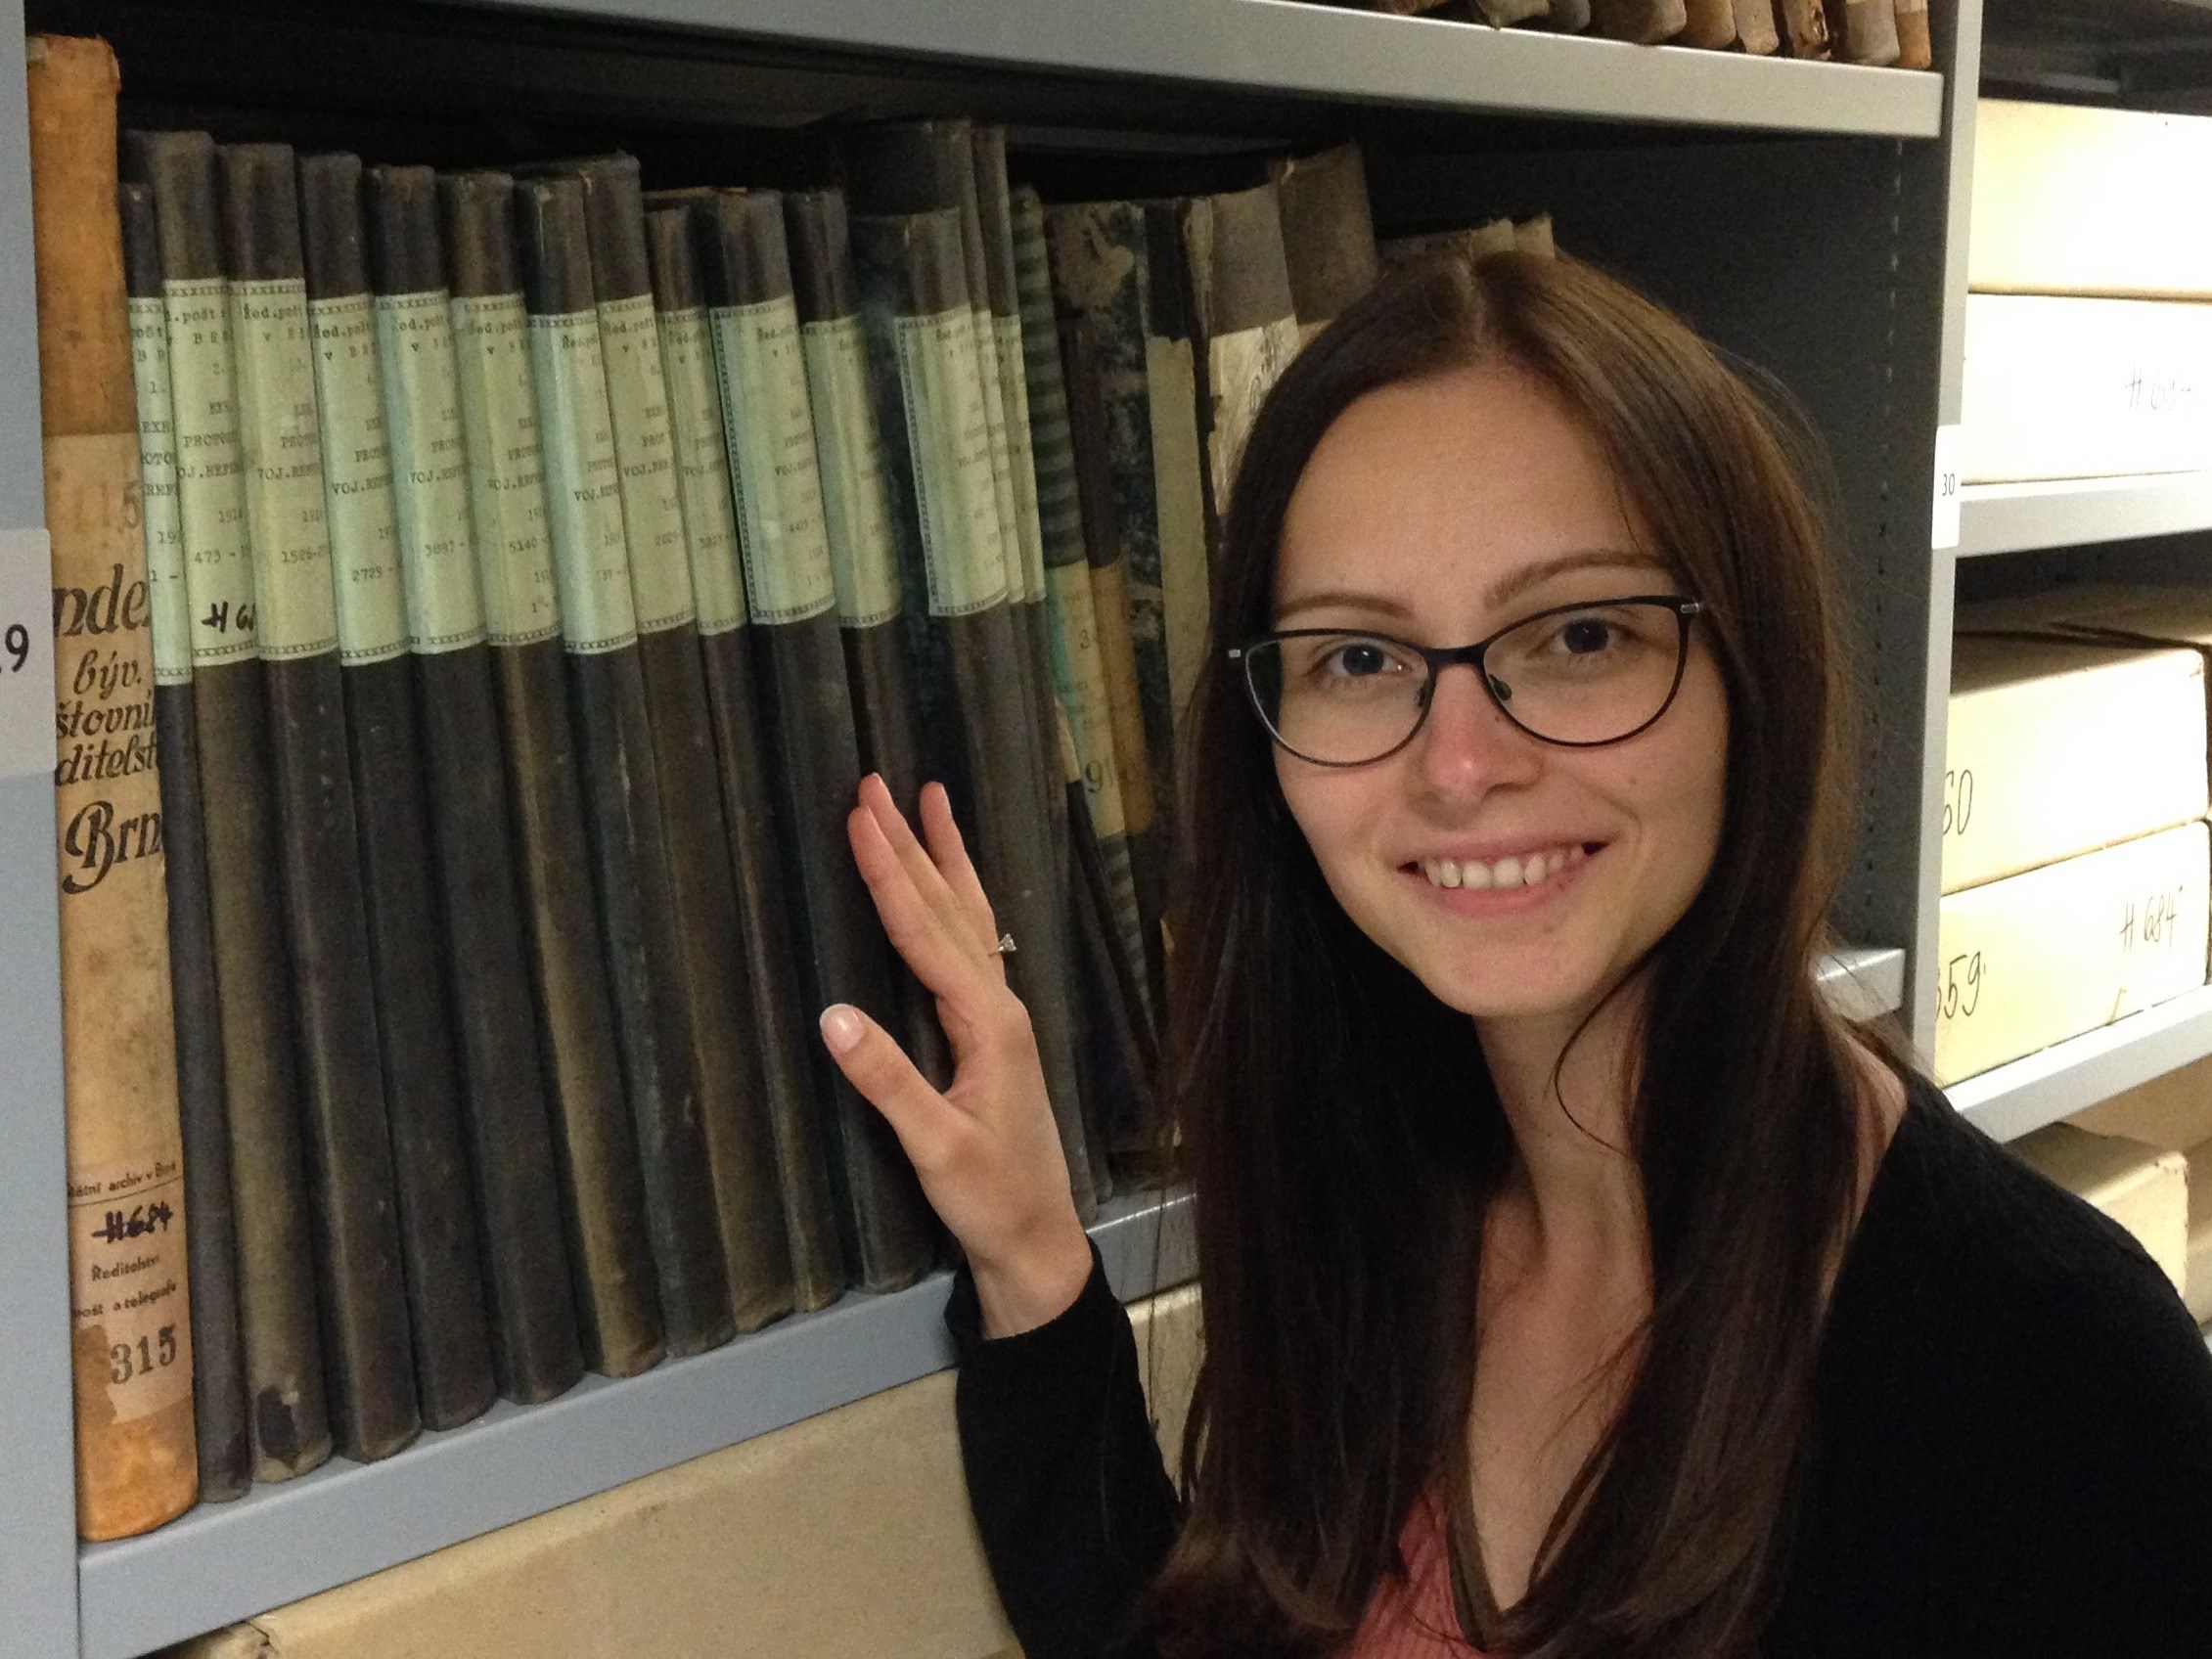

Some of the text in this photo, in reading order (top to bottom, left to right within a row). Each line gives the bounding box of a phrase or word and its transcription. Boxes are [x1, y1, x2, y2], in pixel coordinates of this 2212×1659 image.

[1941, 472, 1956, 496] 30
[53, 563, 149, 639] nde
[0, 624, 29, 674] 9
[72, 647, 142, 700] býv.
[1936, 950, 1982, 1019] 59
[109, 1323, 177, 1385] 315
